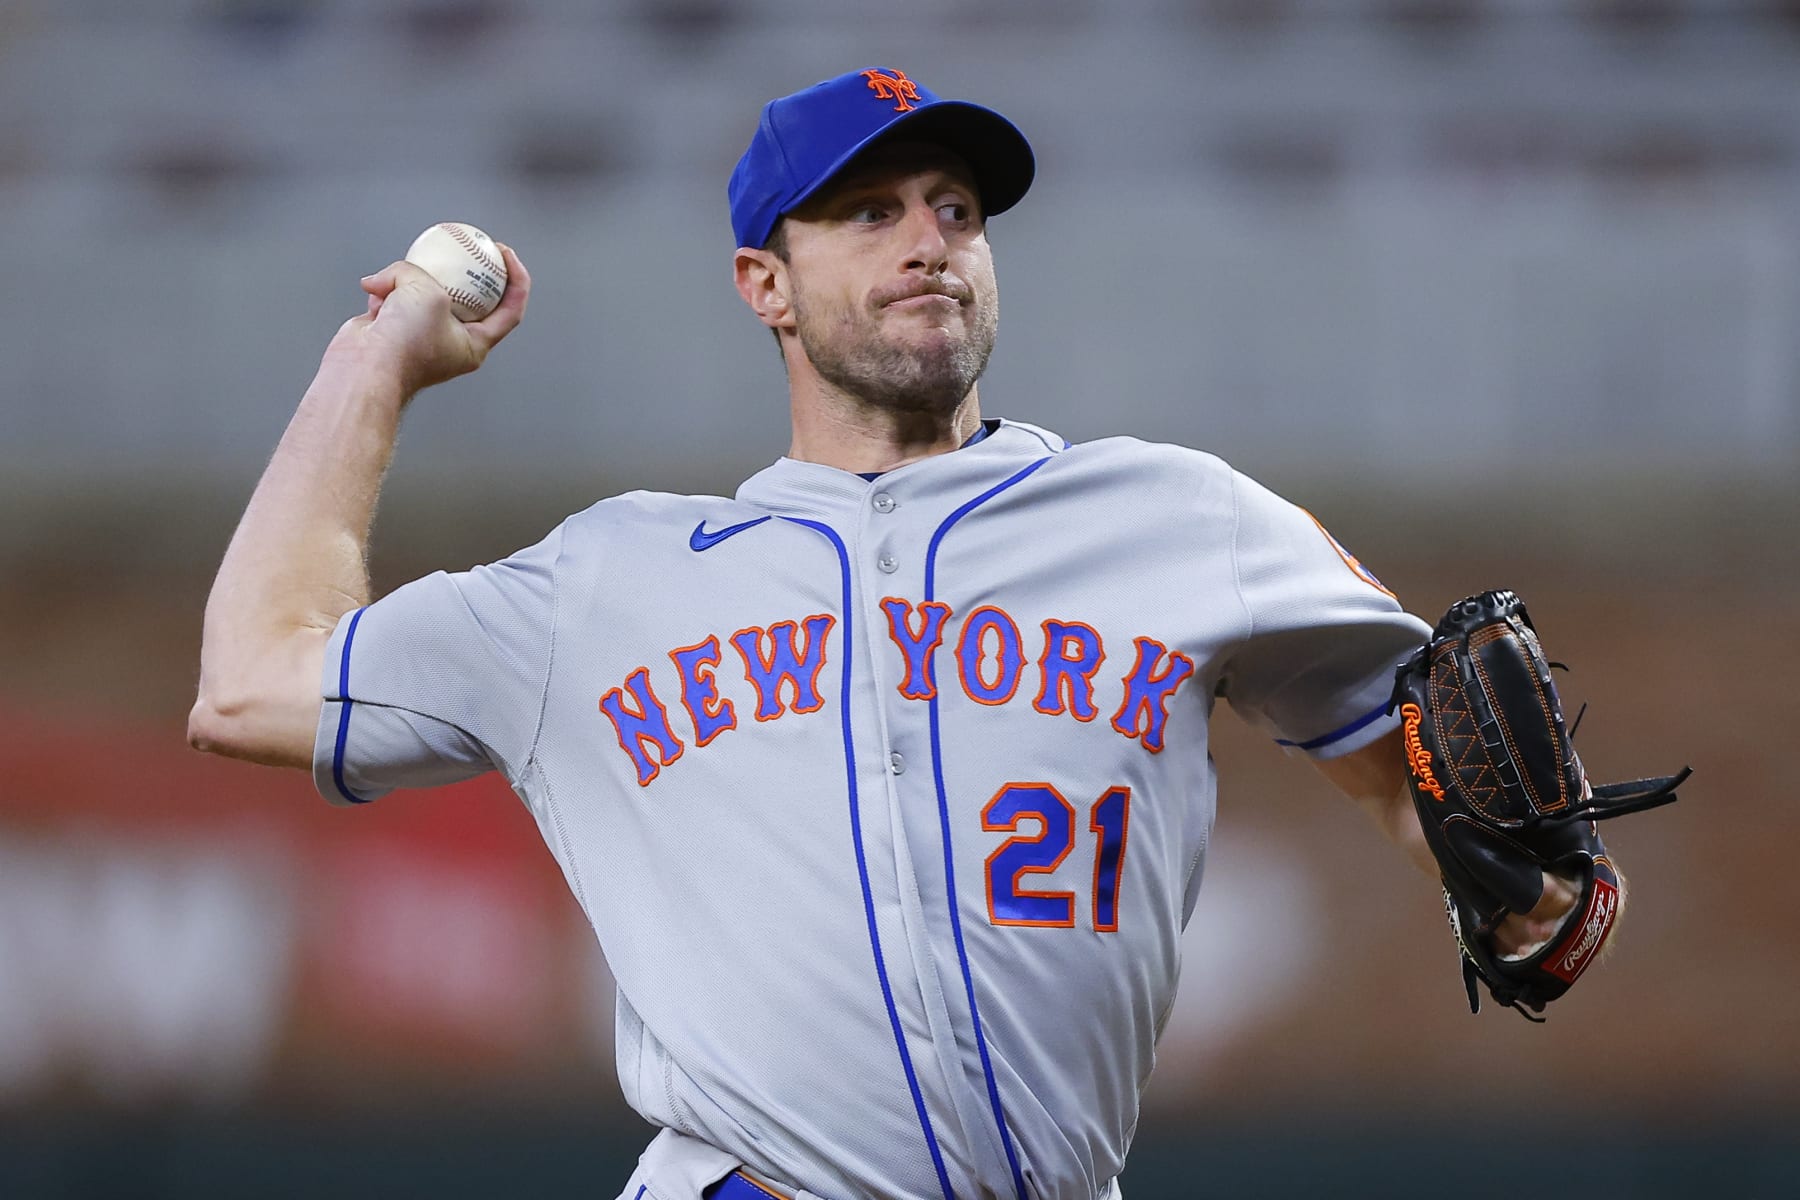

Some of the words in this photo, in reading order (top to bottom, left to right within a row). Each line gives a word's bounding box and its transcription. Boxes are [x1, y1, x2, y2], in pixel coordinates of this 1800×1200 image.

[600, 614, 836, 787] NEW
[880, 596, 1194, 754] YORK
[1401, 703, 1445, 801] Rawlings
[980, 781, 1131, 932] 21
[1564, 890, 1606, 971] Rawlings
